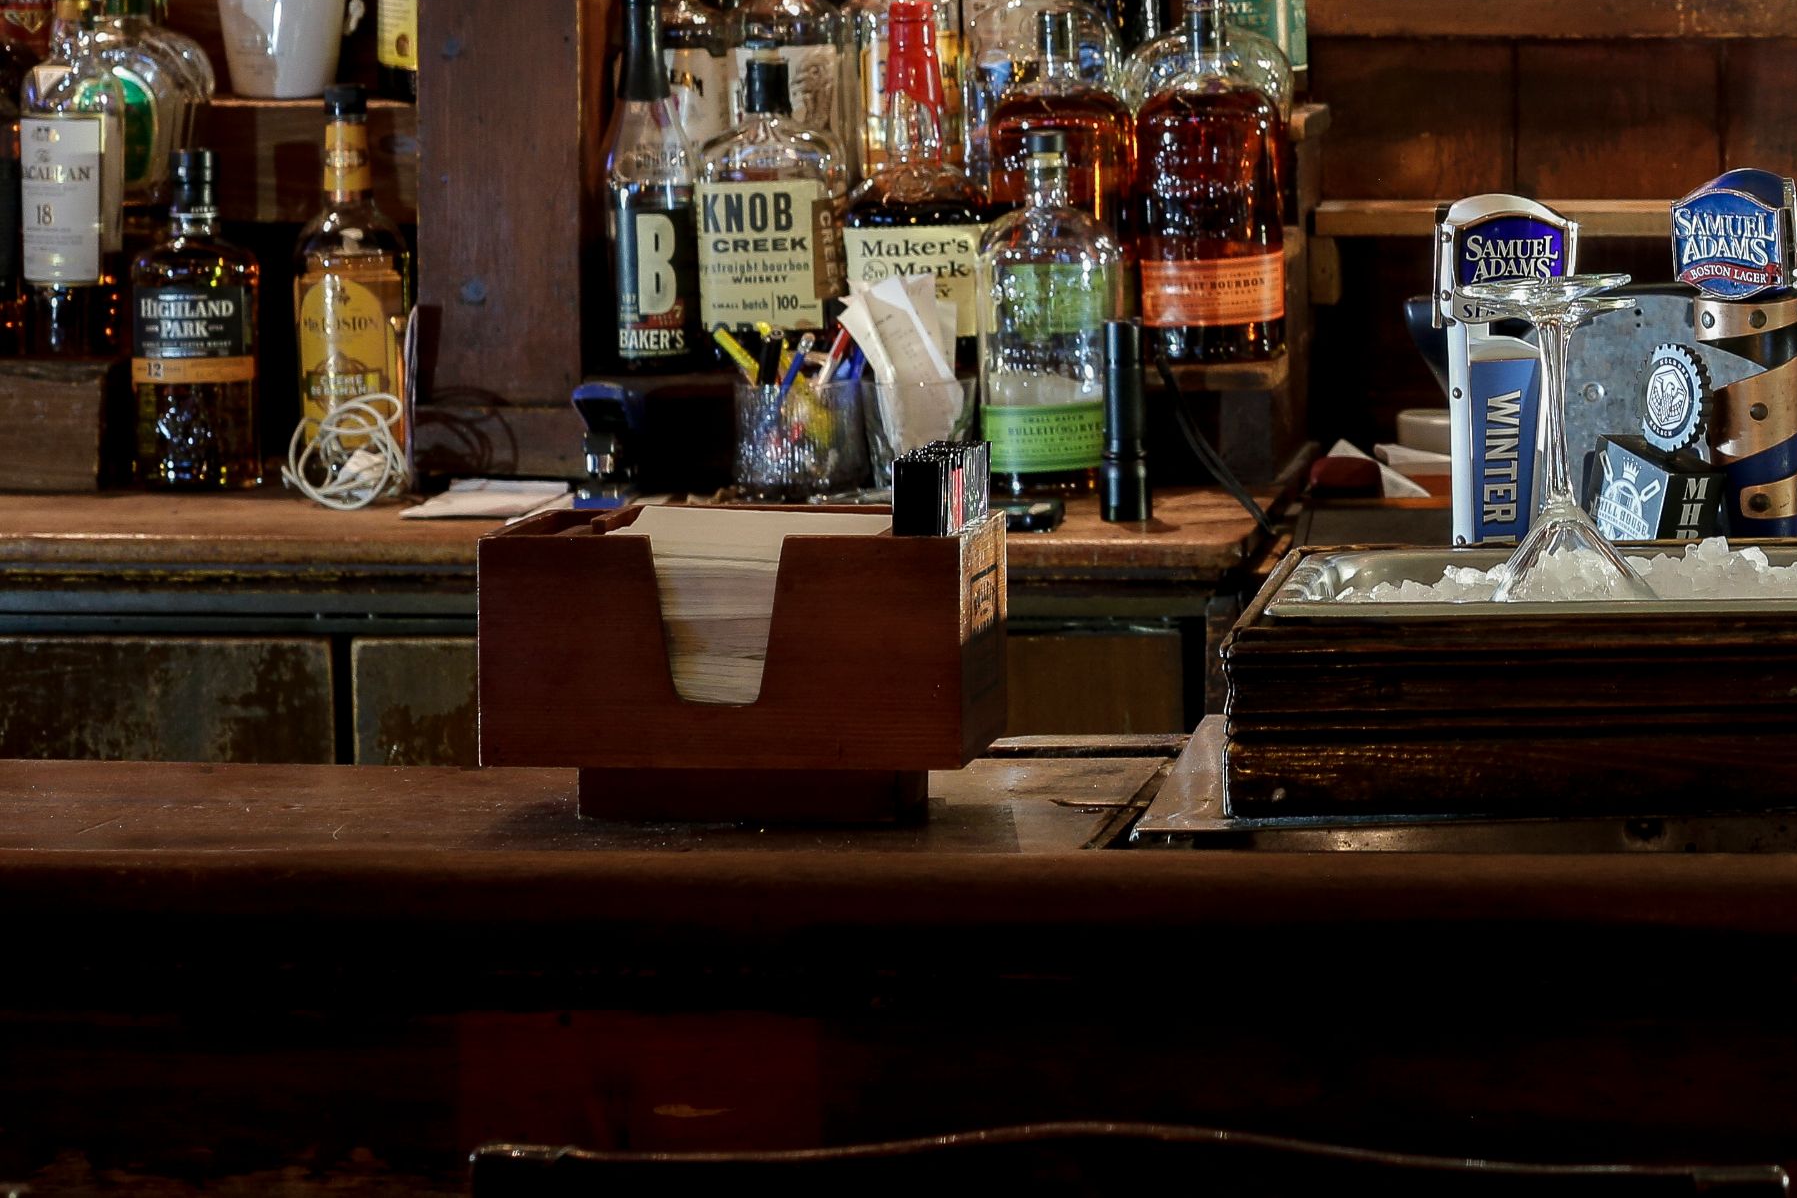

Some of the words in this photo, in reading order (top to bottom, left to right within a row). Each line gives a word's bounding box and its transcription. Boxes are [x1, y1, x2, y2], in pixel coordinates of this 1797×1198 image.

[36, 203, 53, 226] 18
[702, 192, 793, 234] KNOB
[1675, 208, 1776, 241] SAMUEL
[712, 237, 808, 253] CREEK
[818, 210, 841, 293] CREEK
[860, 238, 970, 258] Maker's
[1466, 235, 1558, 261] SAMUEL
[1683, 236, 1768, 266] ADAMS
[636, 213, 677, 315] B
[711, 259, 758, 275] straight
[762, 258, 810, 273] bourbon
[893, 261, 971, 278] Mark
[1471, 258, 1551, 283] ADAMS
[1690, 264, 1731, 281] BOSTON
[1734, 269, 1766, 283] LAGER
[732, 275, 788, 284] WHISKEY
[1210, 278, 1265, 290] BOURBON
[141, 298, 234, 318] HIGHLAND
[742, 296, 769, 310] batch
[776, 295, 799, 310] 100
[160, 319, 209, 339] PARK
[619, 329, 685, 350] BAKER'S
[147, 362, 164, 379] 12
[1482, 390, 1522, 524] WINTER
[1620, 510, 1648, 536] HOUSE
